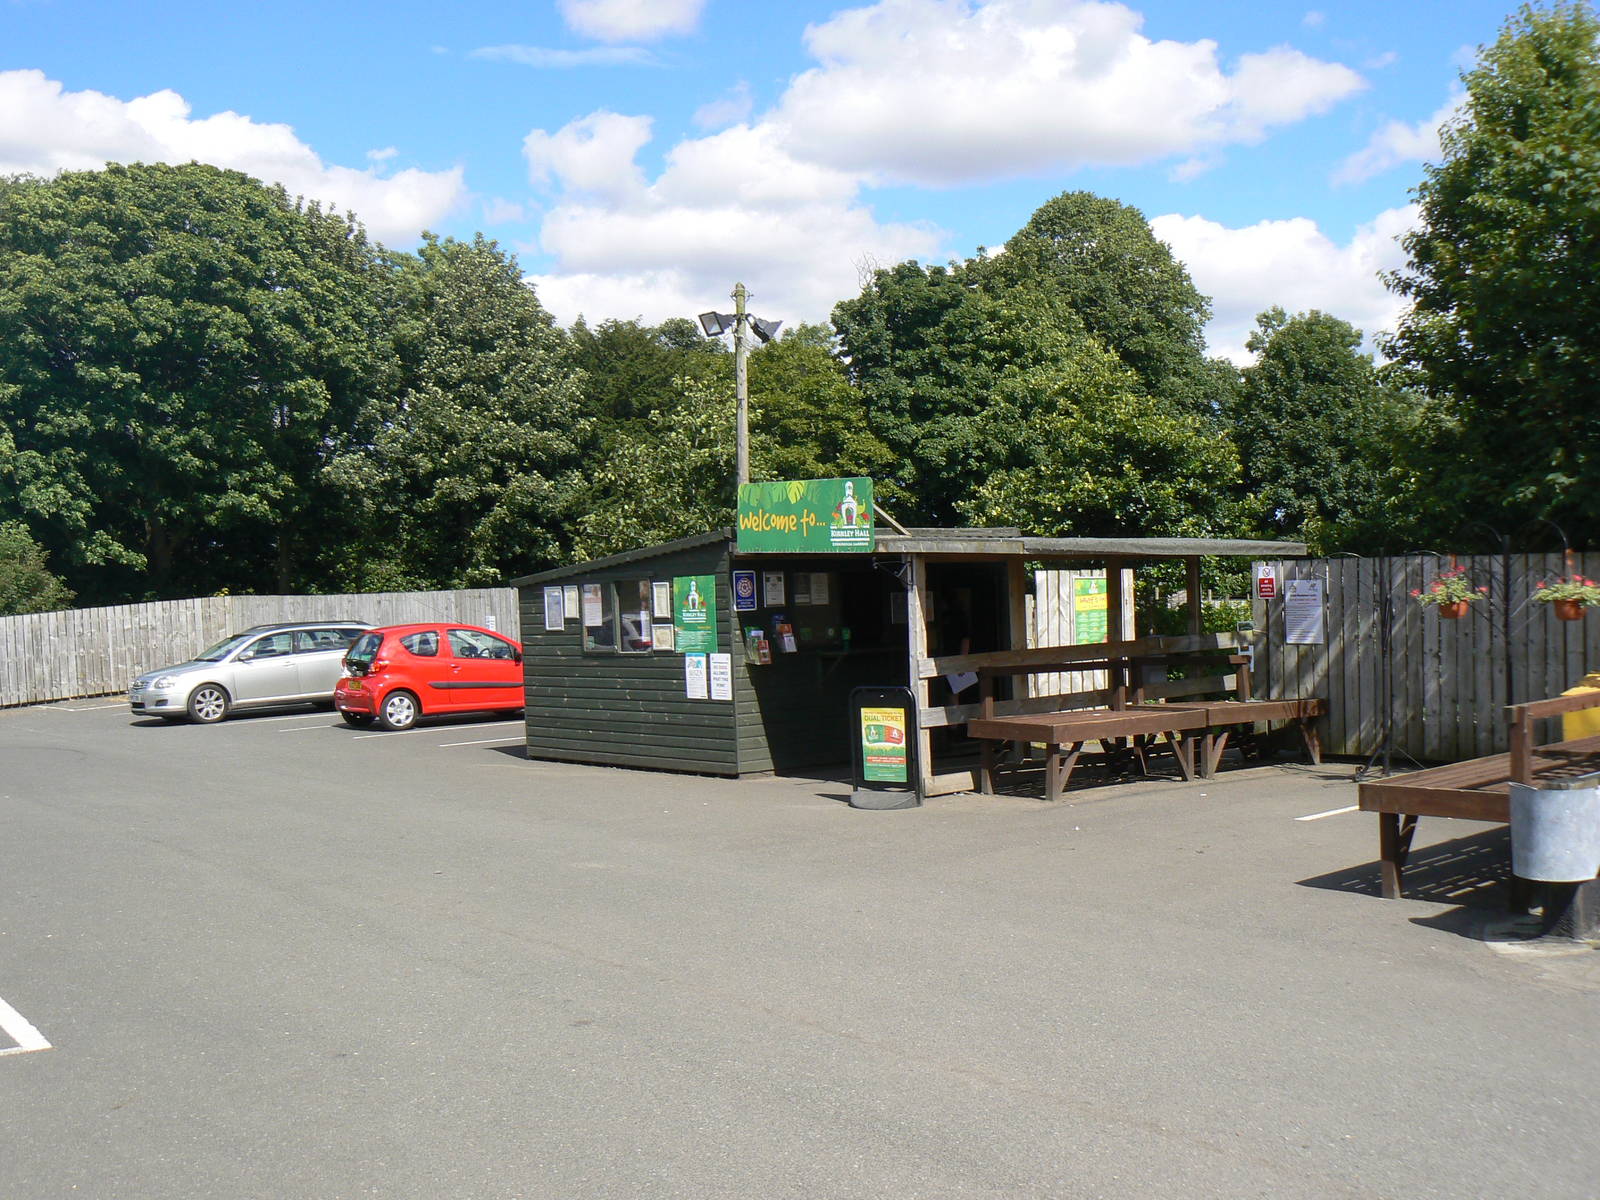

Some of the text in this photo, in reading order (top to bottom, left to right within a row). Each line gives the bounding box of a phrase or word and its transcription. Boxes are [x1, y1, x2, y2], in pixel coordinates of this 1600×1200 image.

[739, 508, 827, 537] welcome to...
[855, 528, 870, 537] HALL
